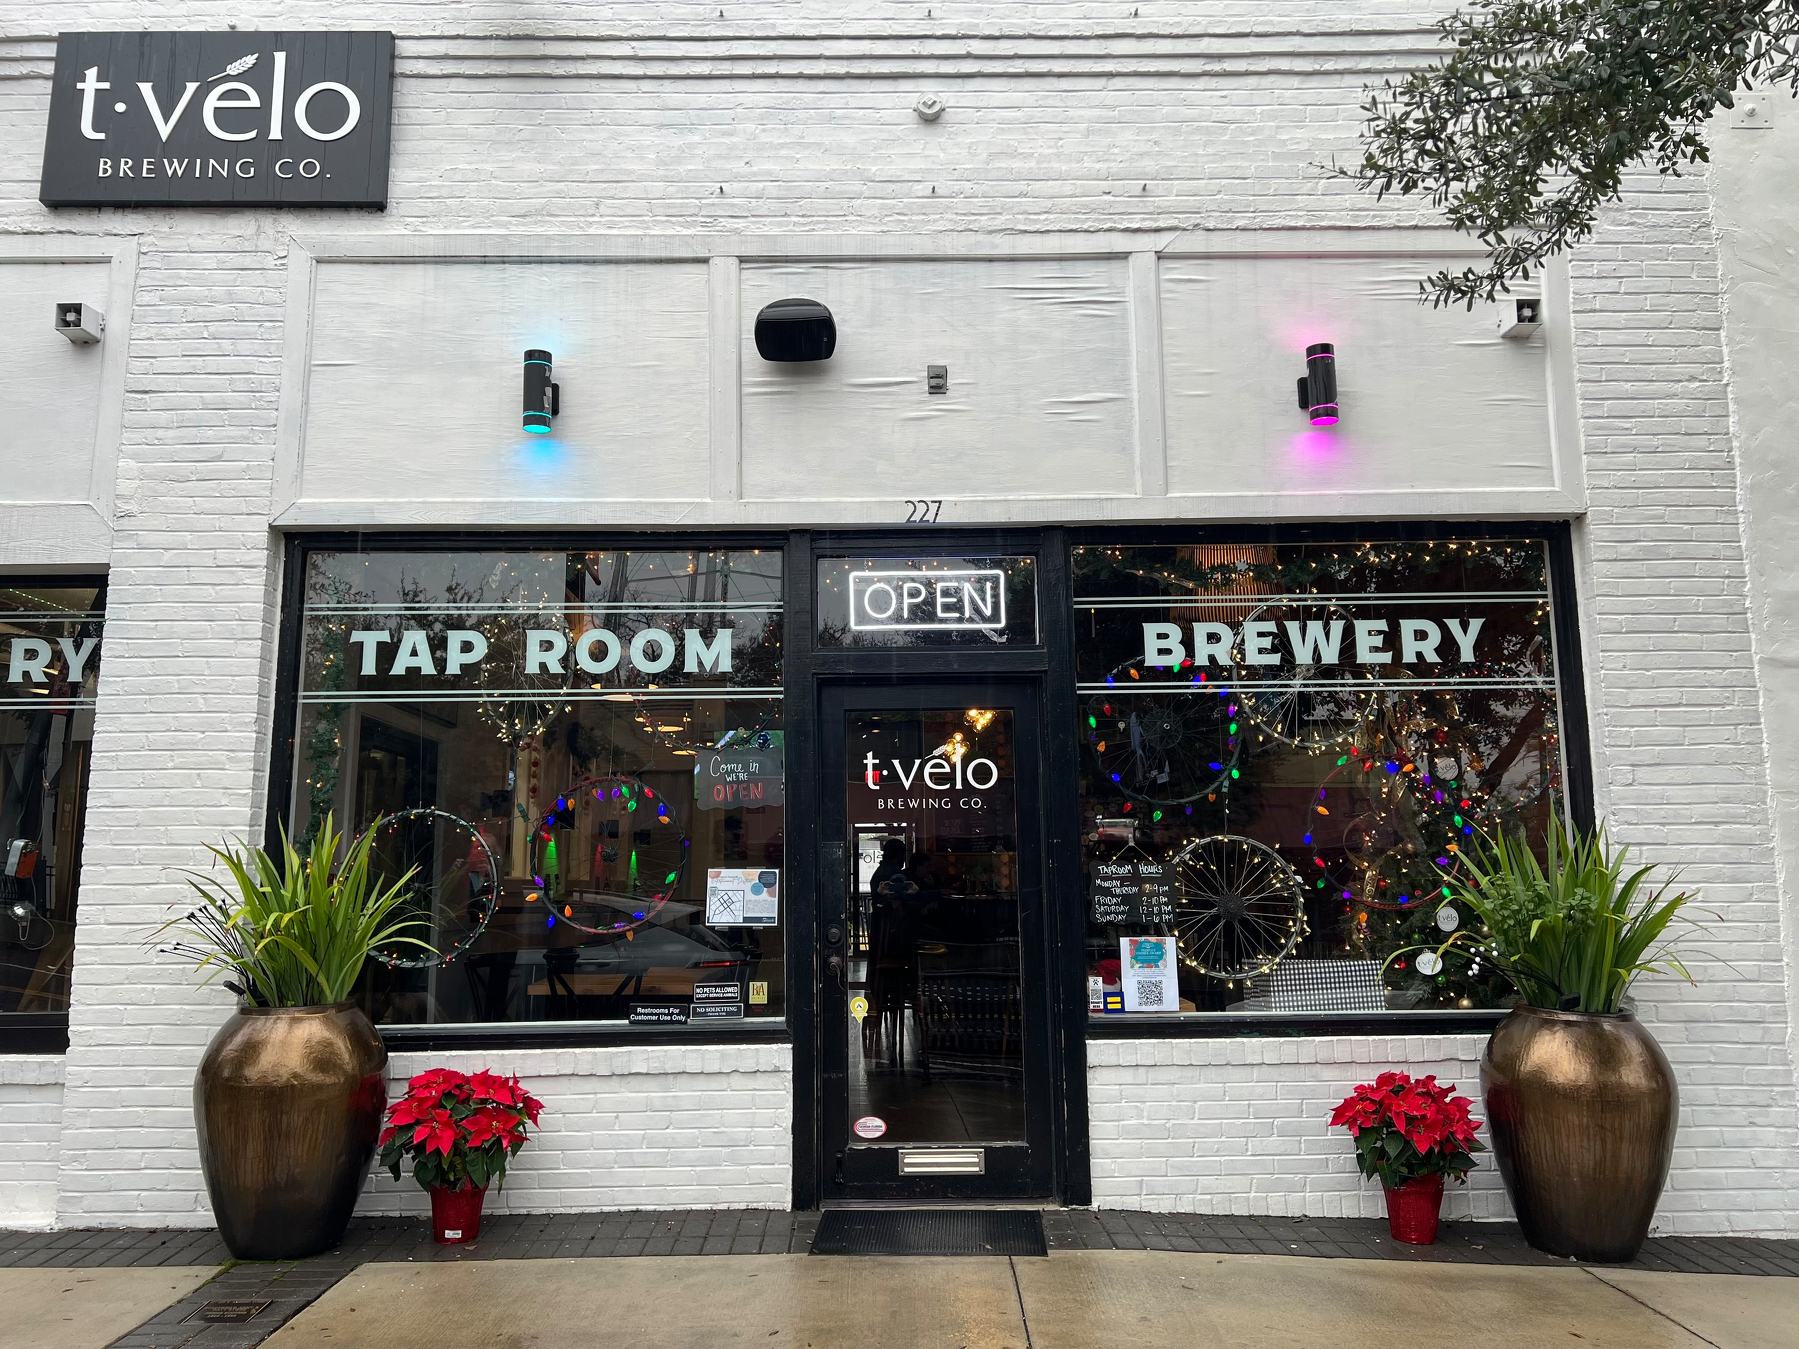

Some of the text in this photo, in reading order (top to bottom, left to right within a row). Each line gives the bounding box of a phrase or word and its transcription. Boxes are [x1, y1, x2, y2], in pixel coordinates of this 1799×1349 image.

[97, 157, 332, 180] BREWING CO.
[904, 500, 943, 524] 227
[863, 581, 993, 619] OPEN
[1142, 618, 1487, 667] BREWERY
[349, 628, 734, 676] TAP ROOM
[6, 637, 101, 683] RY
[710, 755, 759, 777] Come in
[725, 772, 748, 781] WE'RE
[865, 770, 881, 783] EIT
[713, 782, 764, 802] OPEN
[877, 797, 988, 810] BREWING CO.
[1098, 863, 1163, 874] TAPROOM HOURS
[1095, 879, 1121, 888] MONDAY
[1110, 886, 1139, 895] THURSDAY
[1095, 895, 1122, 905] FRIDAY
[1160, 895, 1168, 903] PM
[1095, 905, 1130, 914] SATURDAY
[1161, 904, 1172, 913] PM
[1095, 914, 1127, 923] SUNDAY
[1162, 914, 1174, 923] PM
[670, 1014, 686, 1022] Only
